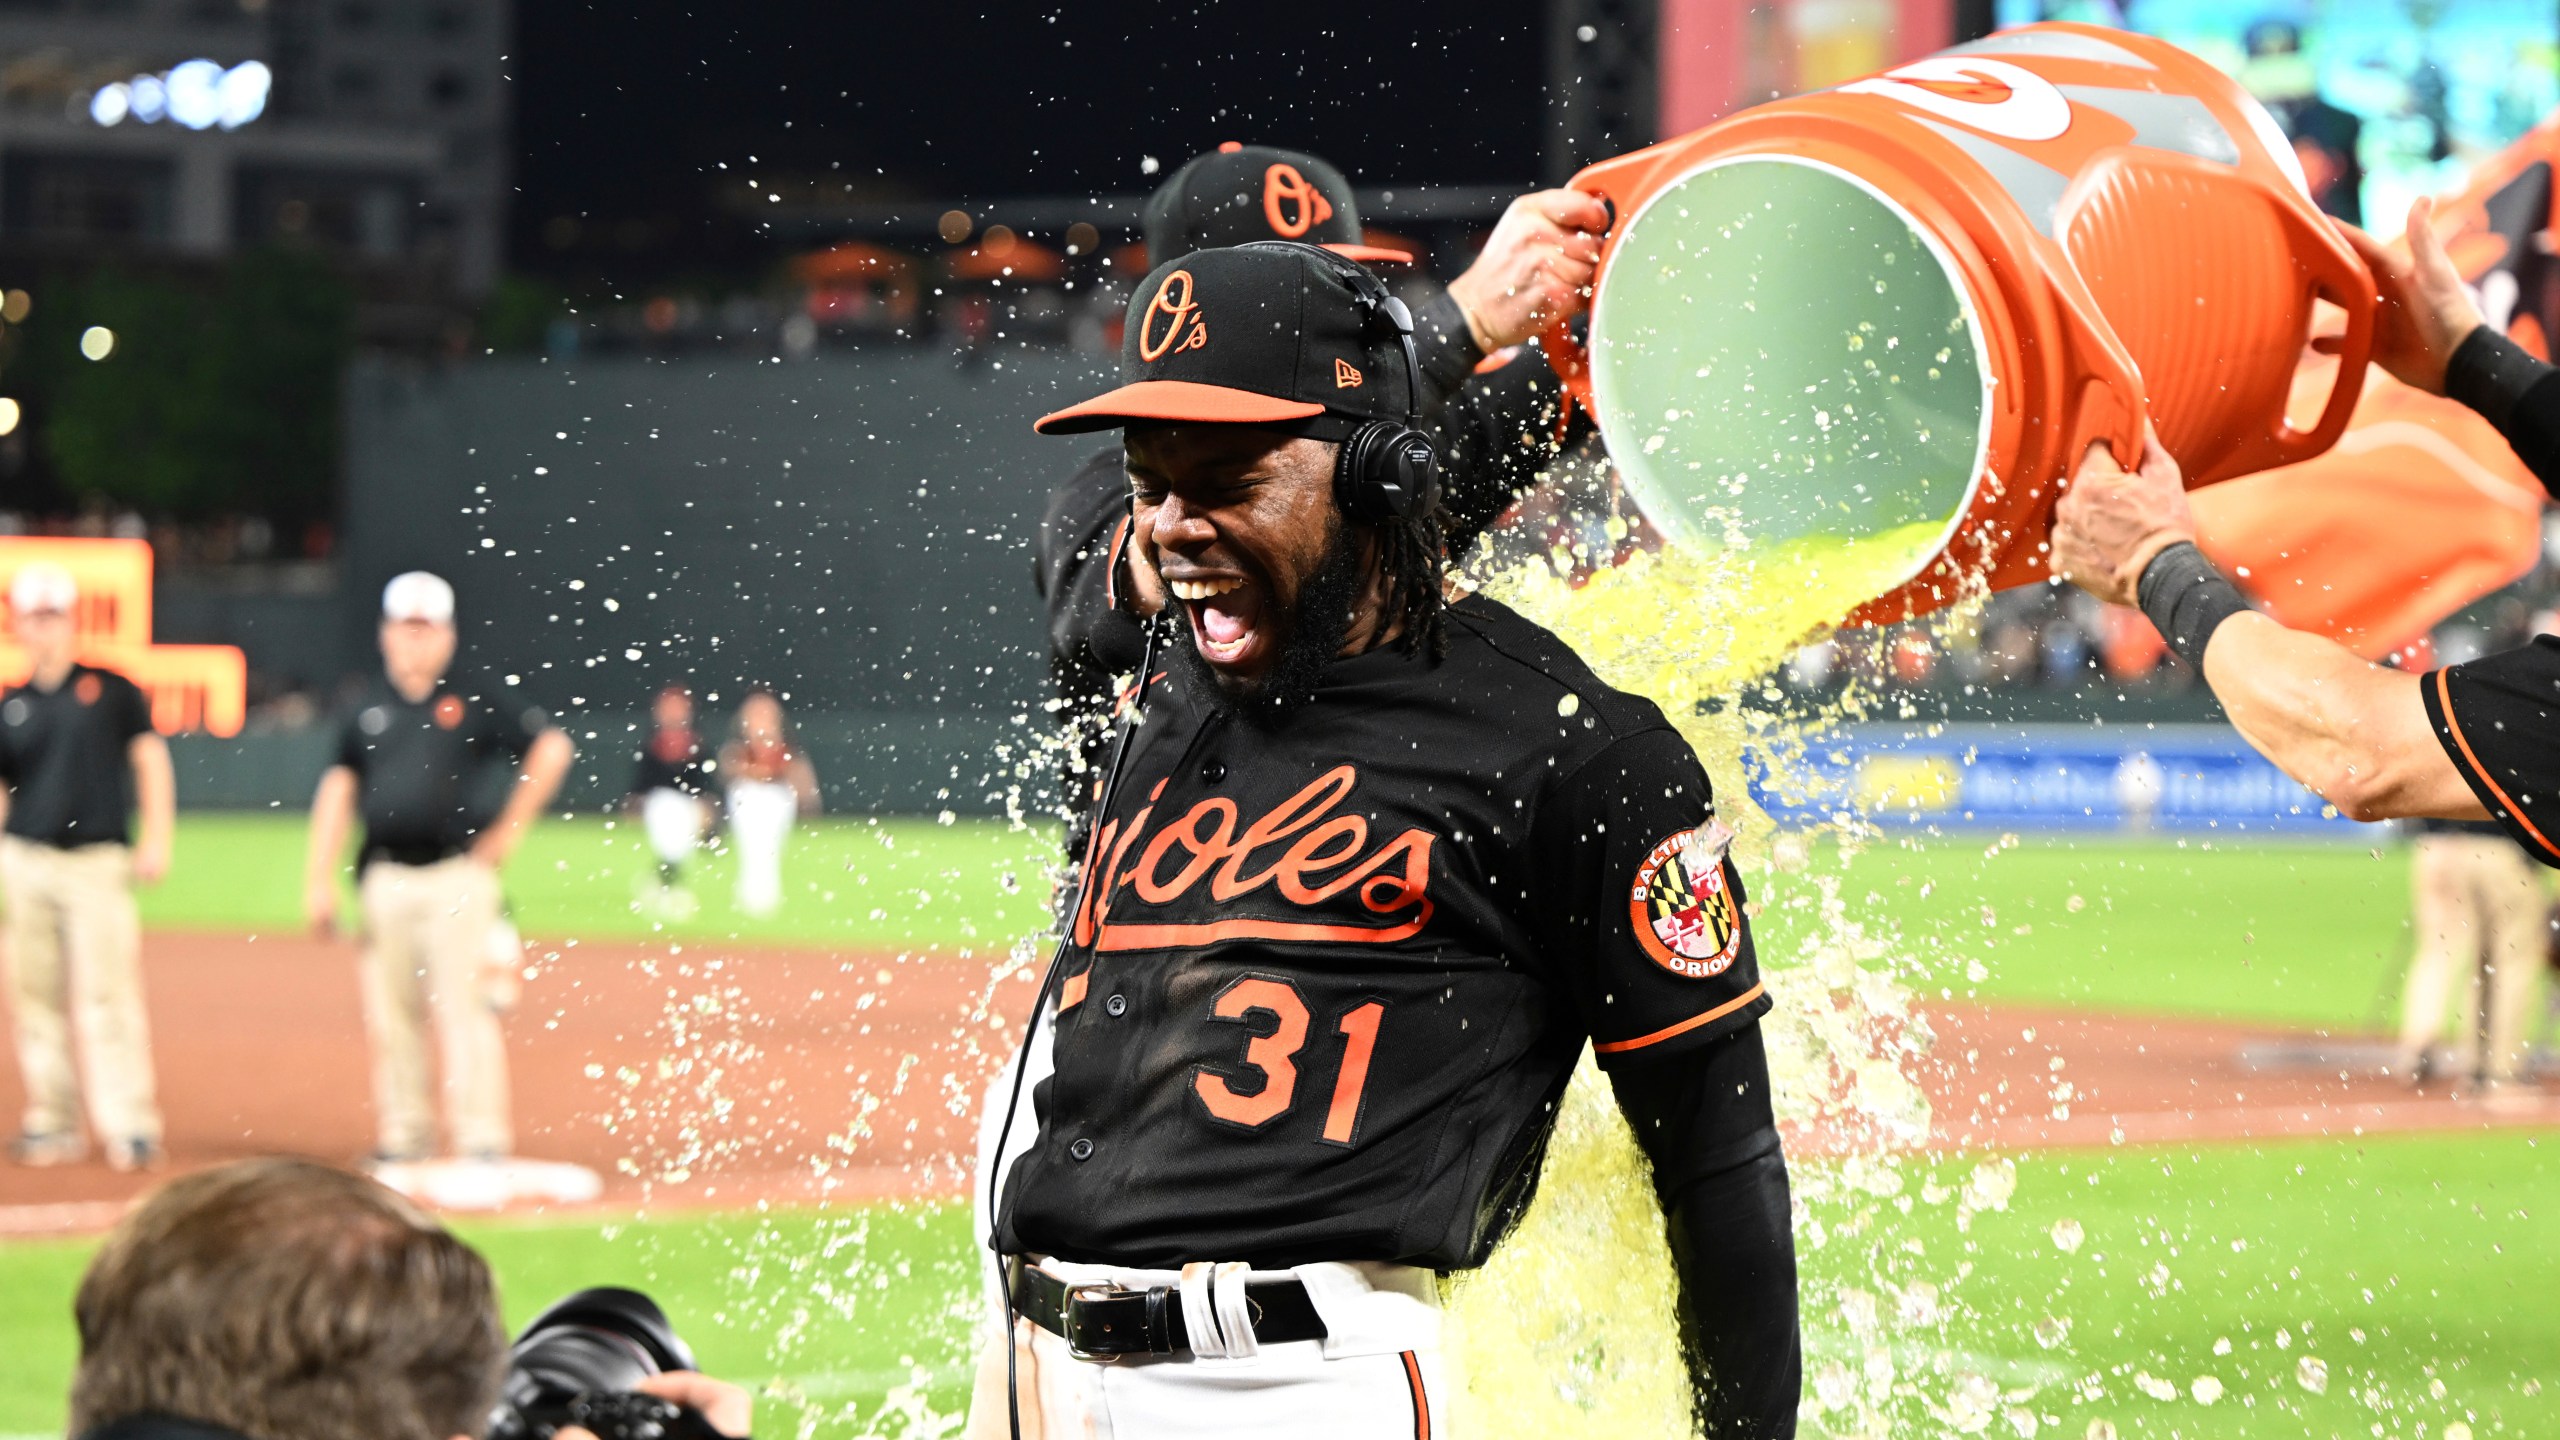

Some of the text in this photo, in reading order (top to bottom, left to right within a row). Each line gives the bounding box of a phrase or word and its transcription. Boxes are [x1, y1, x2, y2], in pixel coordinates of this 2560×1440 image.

[1140, 270, 1208, 362] O's
[1633, 832, 1693, 902] BALTIM
[1669, 927, 1741, 977] ORIOLES
[1191, 974, 1387, 1147] 31
